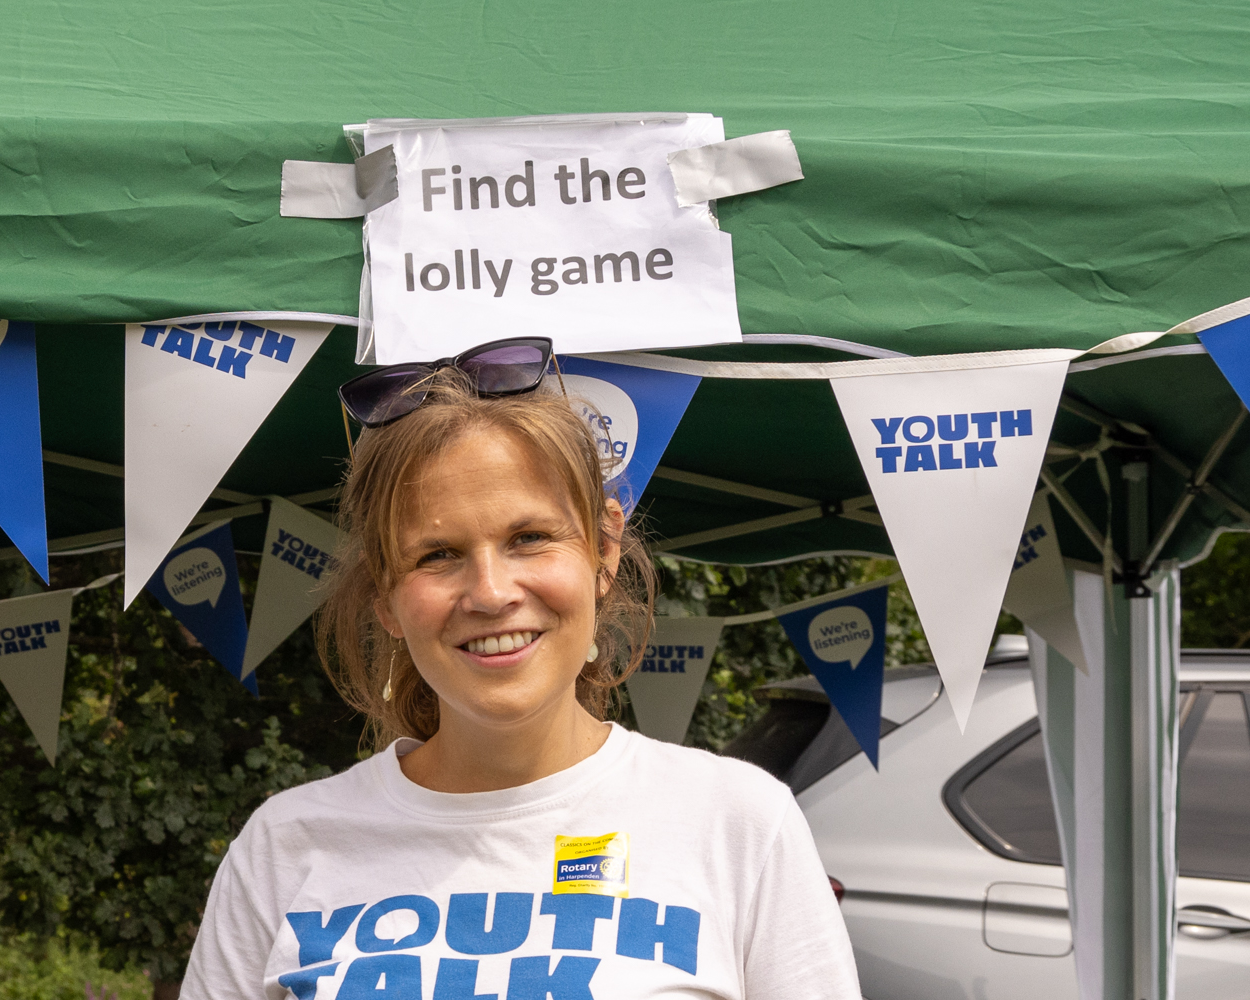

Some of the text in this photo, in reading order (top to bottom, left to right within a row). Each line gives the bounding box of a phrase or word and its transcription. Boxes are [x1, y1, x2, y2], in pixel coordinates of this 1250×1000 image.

[421, 156, 648, 213] Find the
[403, 242, 675, 298] lolly game
[141, 324, 253, 380] TALK
[178, 321, 296, 364] UTH
[870, 409, 1033, 444] YOUTH
[875, 441, 998, 474] TALK
[271, 542, 324, 580] TALK
[172, 566, 222, 596] listening
[814, 629, 870, 650] listening
[560, 863, 598, 873] Rotary
[285, 892, 701, 976] YOUTH
